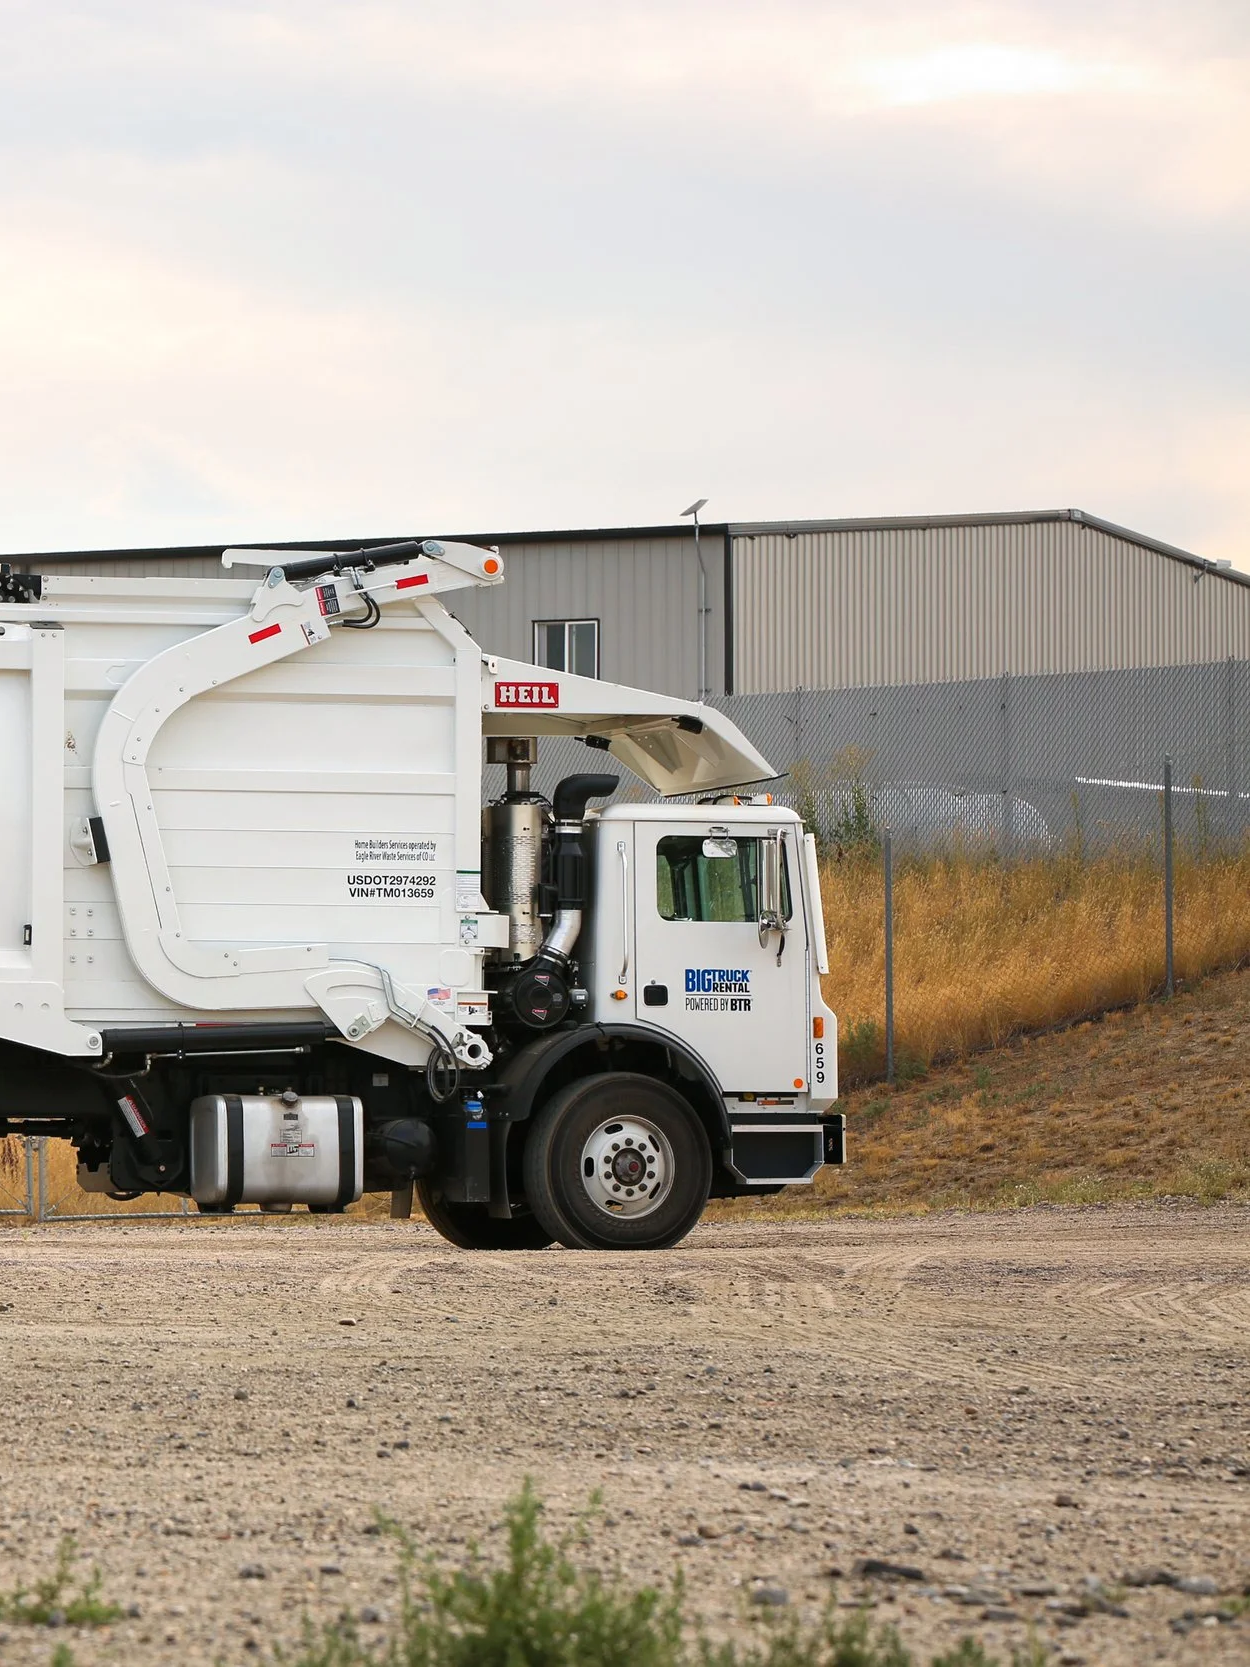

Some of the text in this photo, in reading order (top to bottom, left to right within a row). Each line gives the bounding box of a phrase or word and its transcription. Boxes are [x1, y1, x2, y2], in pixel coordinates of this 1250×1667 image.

[499, 686, 555, 704] HEIL
[355, 840, 436, 852] Home Builders Services operated by
[356, 851, 369, 863] Eagle
[369, 851, 382, 861] River
[382, 852, 396, 861] Waste
[397, 852, 416, 861] Services
[416, 852, 422, 861] of
[422, 852, 429, 862] CO
[347, 875, 437, 886] USDOT2974292
[349, 888, 434, 898] VIN#TM013659
[713, 983, 750, 992] RENTAL
[685, 998, 751, 1011] POWERED BY BTR
